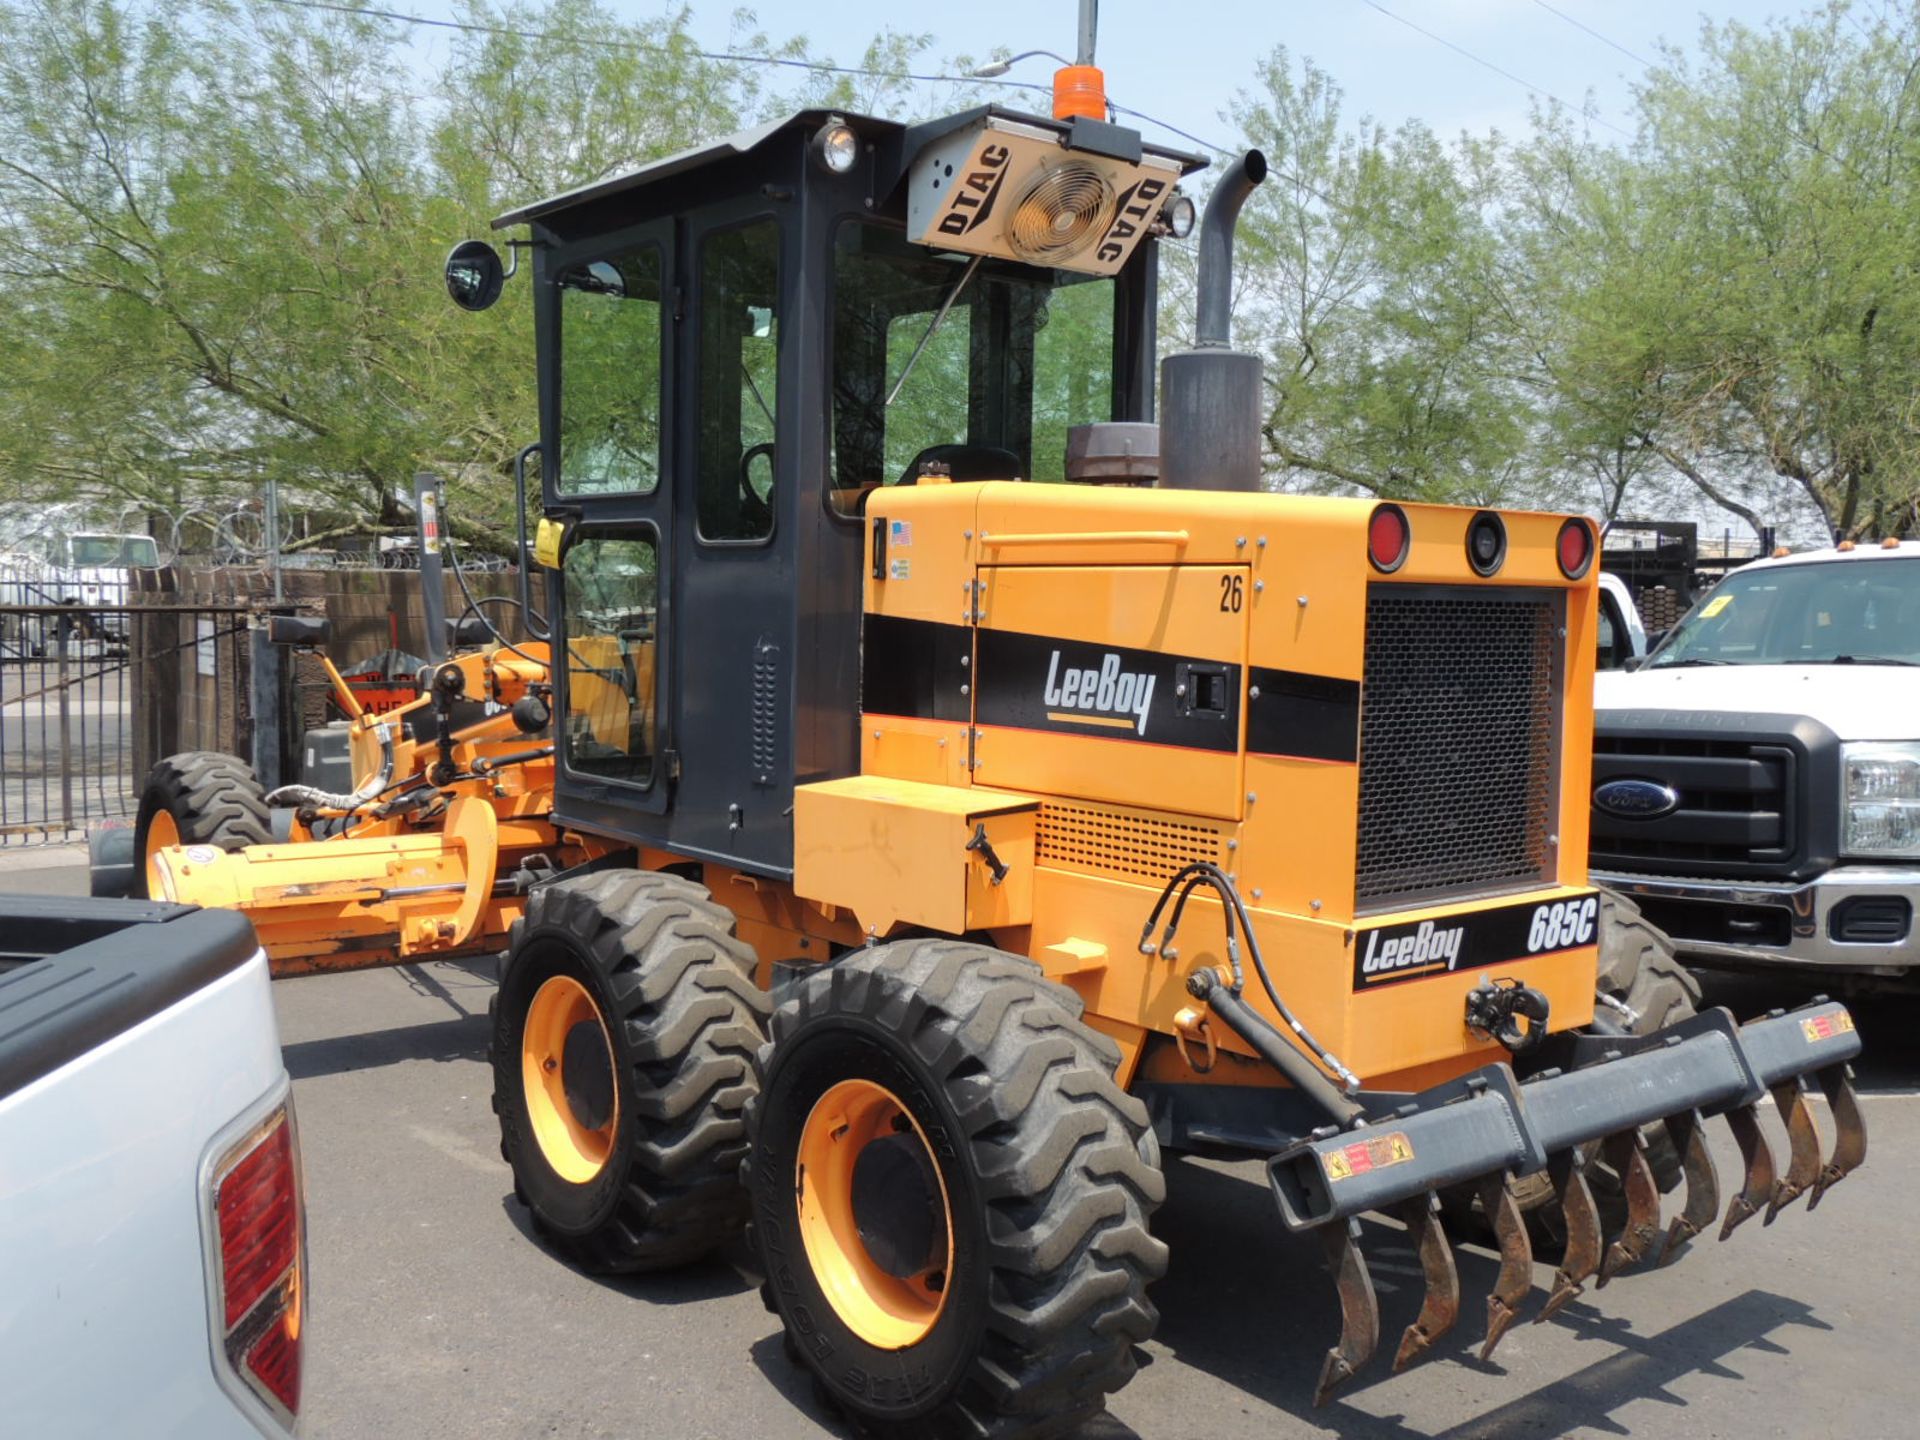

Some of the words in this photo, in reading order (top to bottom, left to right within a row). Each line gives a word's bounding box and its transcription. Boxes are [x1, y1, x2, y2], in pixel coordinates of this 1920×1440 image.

[938, 144, 1009, 236] DTAC
[1097, 178, 1166, 262] DTAC
[1219, 574, 1243, 613] 26
[1044, 651, 1156, 736] LeeBoy
[1363, 920, 1463, 971] LeeBoy
[1527, 898, 1597, 952] 685C
